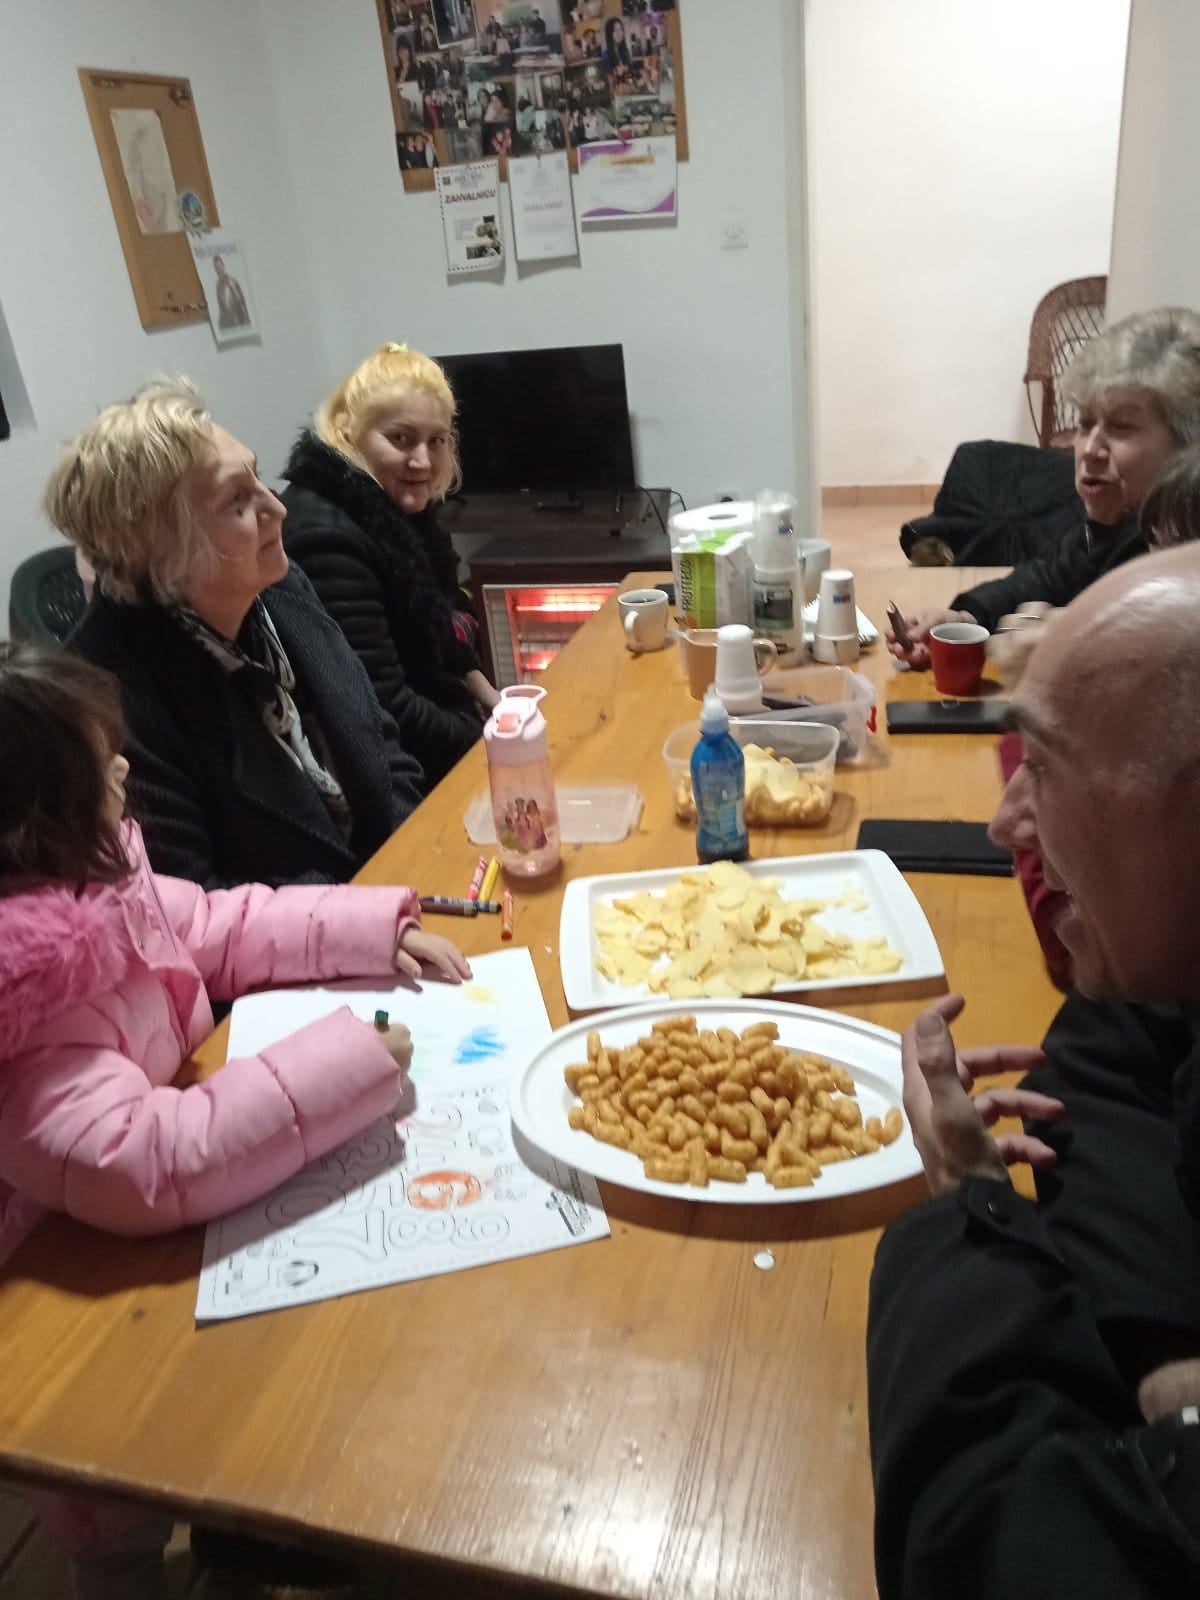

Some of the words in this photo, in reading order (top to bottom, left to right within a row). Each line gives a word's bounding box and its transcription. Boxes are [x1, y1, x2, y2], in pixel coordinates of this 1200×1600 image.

[407, 1169, 481, 1210] 6
[294, 1209, 388, 1263] 7
[388, 1212, 456, 1249] 8
[451, 1213, 511, 1250] 9
